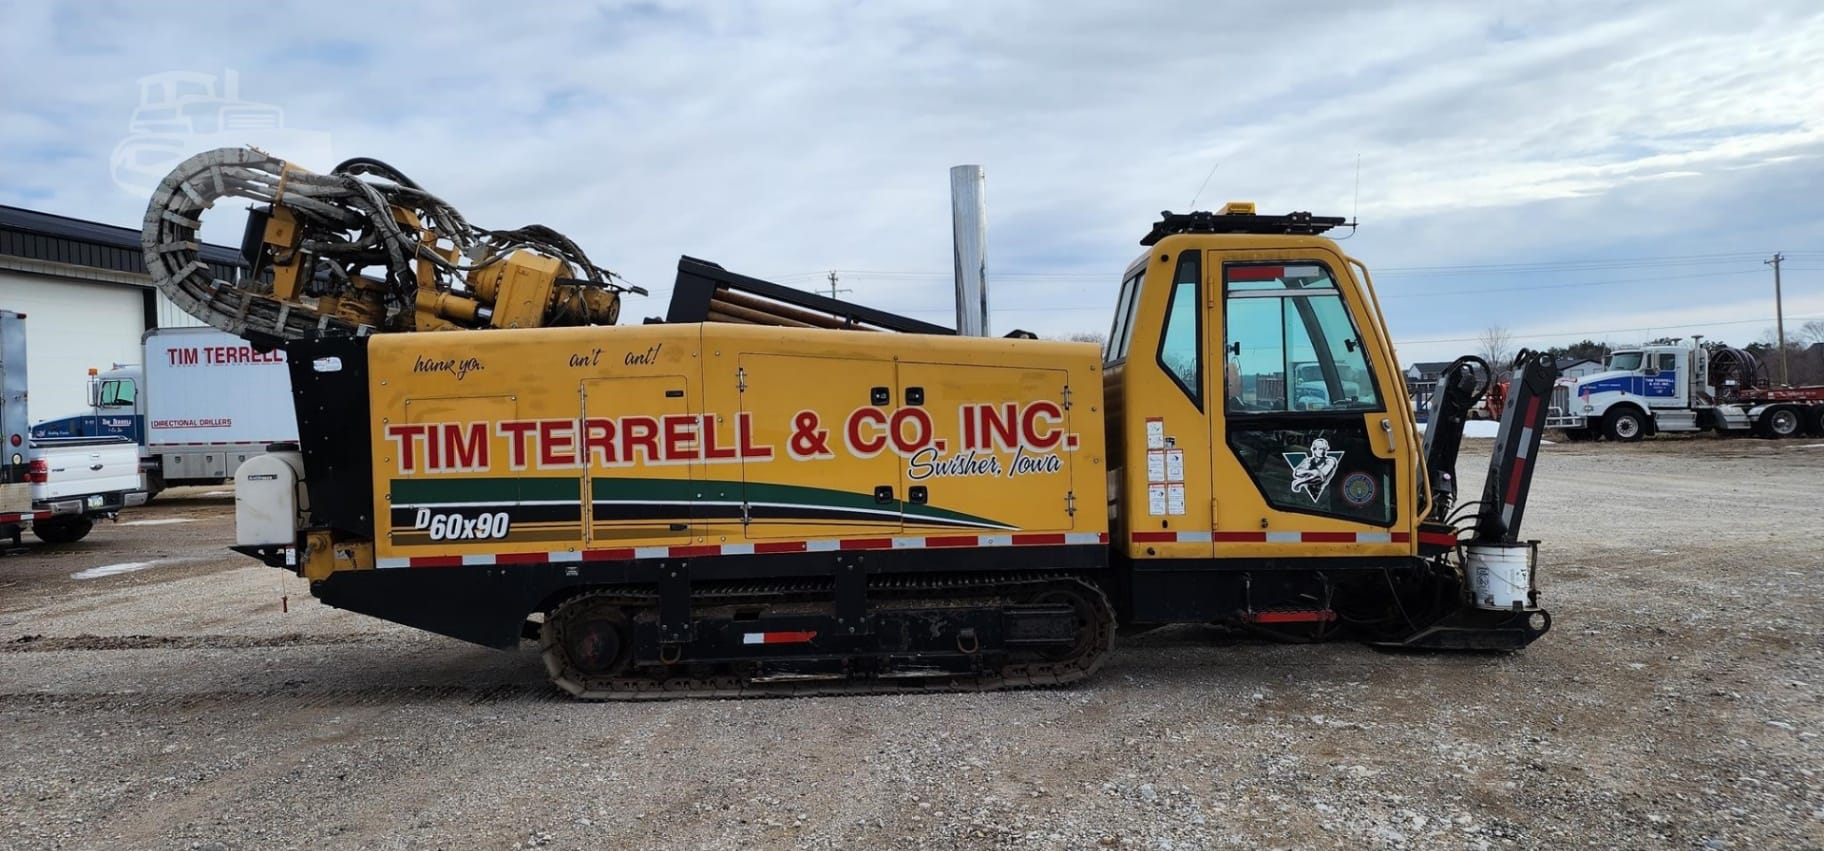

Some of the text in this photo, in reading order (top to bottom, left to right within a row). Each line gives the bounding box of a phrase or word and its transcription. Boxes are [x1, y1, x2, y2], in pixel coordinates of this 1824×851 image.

[167, 346, 284, 365] TIM TERRELL
[387, 400, 1080, 473] TIM TERRELL & CO. INC.
[1007, 444, 1062, 478] Iowa
[414, 507, 510, 540] D60x90
